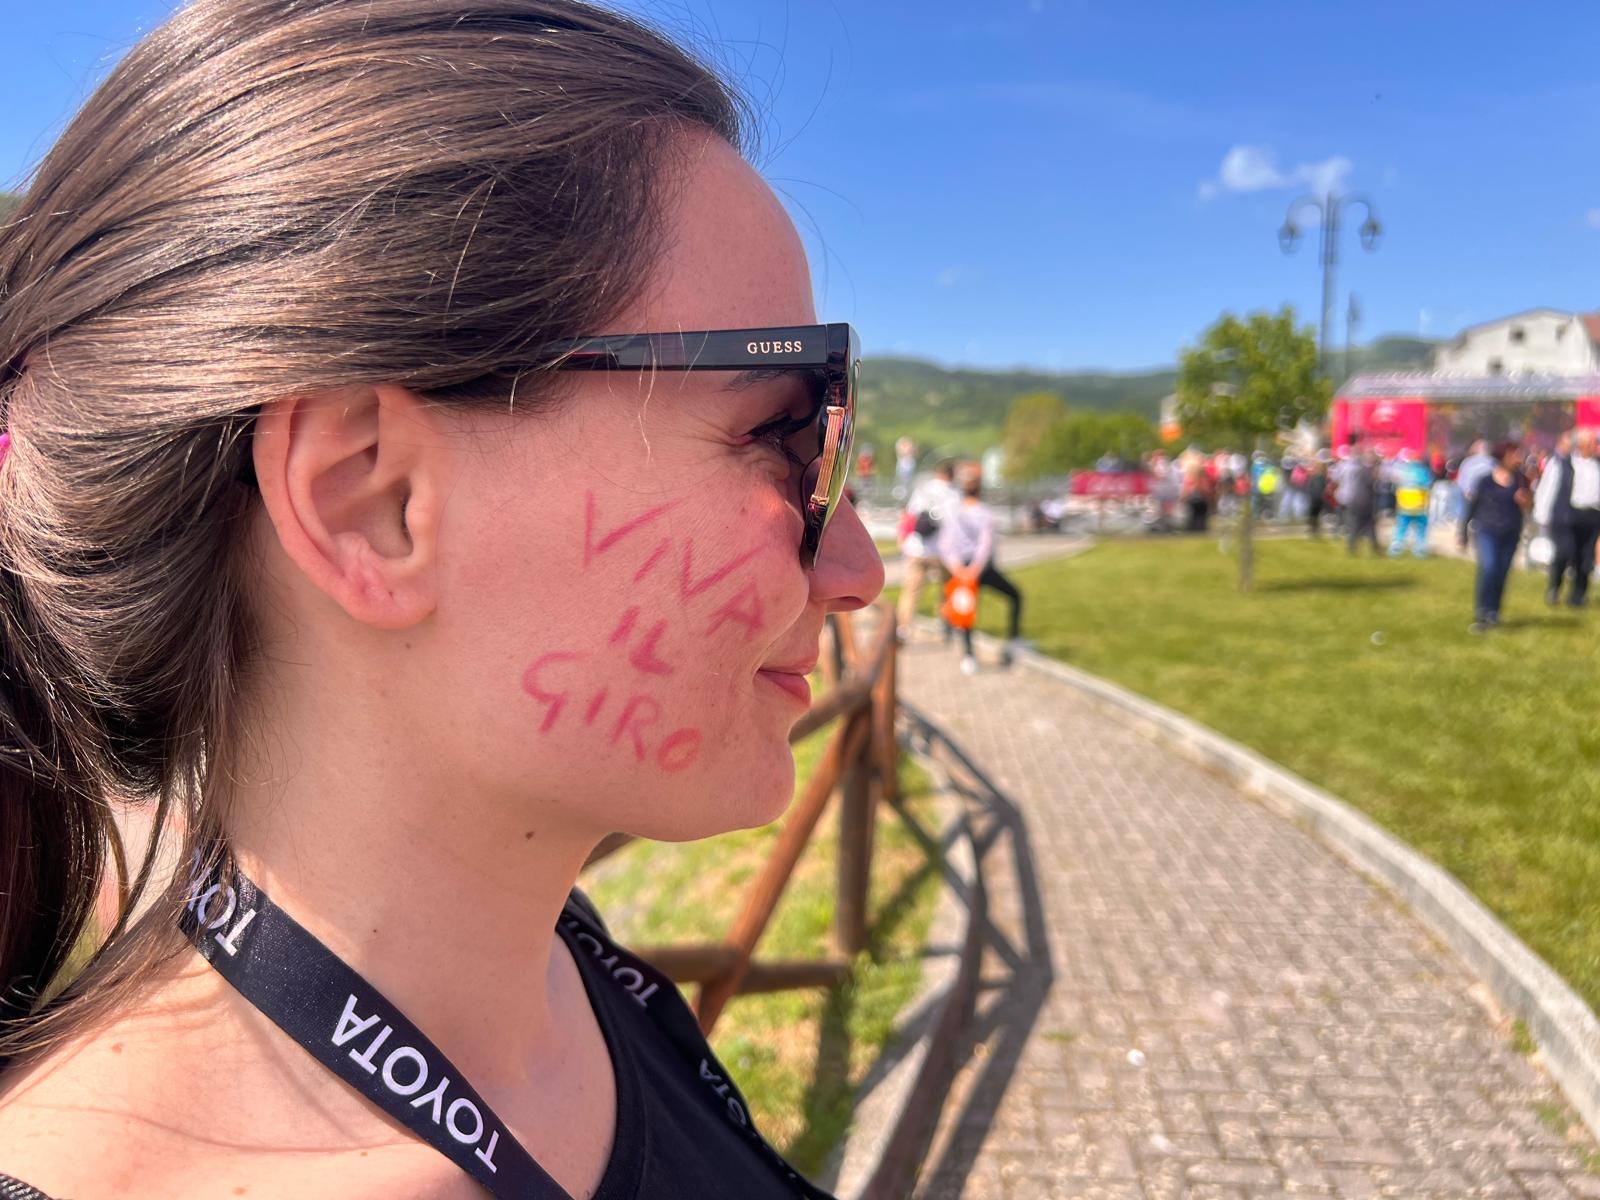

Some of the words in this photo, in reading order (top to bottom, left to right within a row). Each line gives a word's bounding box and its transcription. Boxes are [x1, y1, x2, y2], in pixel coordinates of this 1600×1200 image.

[746, 340, 803, 355] GUESS
[582, 489, 767, 642] VIVA
[608, 604, 674, 677] IL
[521, 650, 704, 774] GIRO
[331, 993, 500, 1174] TOYOTA
